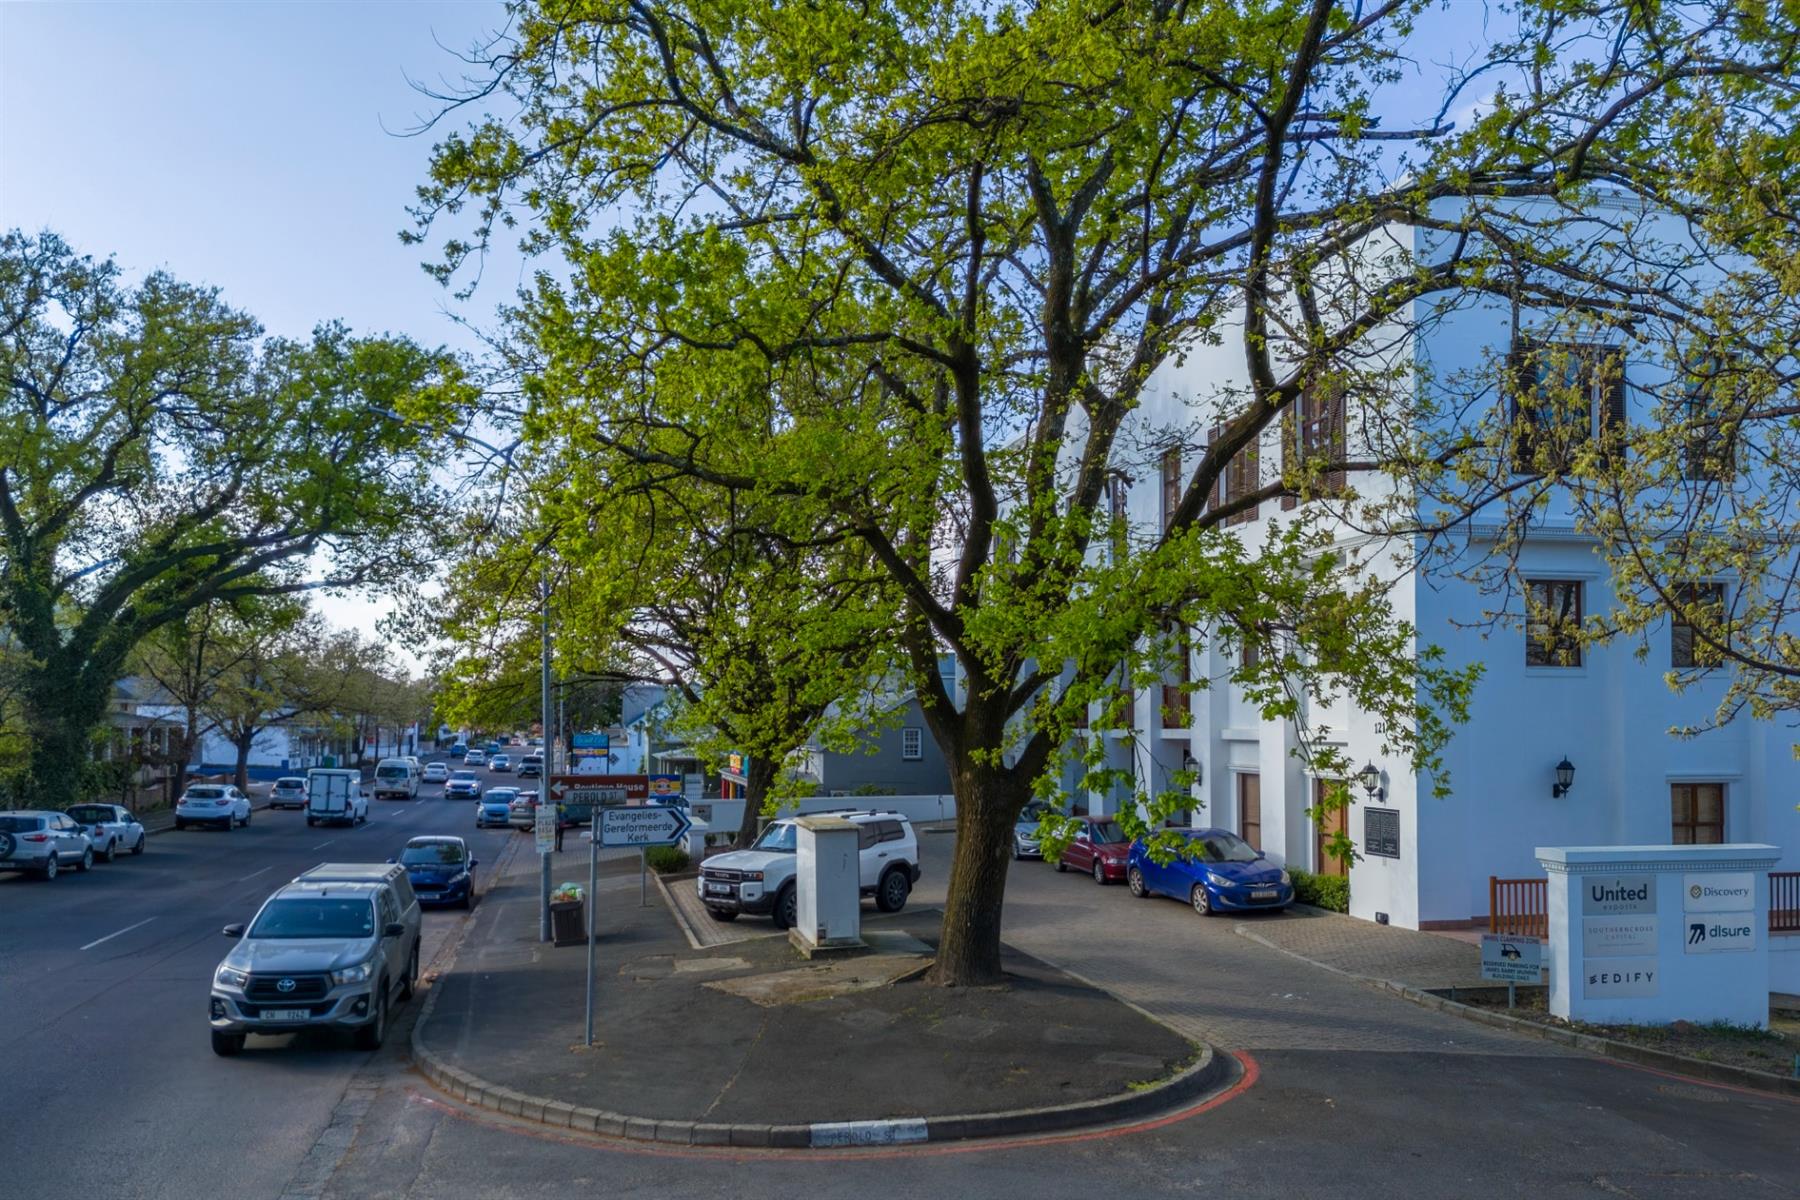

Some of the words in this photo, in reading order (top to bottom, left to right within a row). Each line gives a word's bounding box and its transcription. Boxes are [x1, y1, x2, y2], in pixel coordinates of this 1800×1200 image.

[573, 791, 607, 801] PEROLD
[608, 811, 662, 822] Evangelies-
[603, 823, 673, 833] Gereformeerde
[627, 833, 649, 842] Kerk
[1592, 882, 1648, 902] United
[1704, 887, 1750, 898] Discovery
[1603, 903, 1637, 911] exports
[1601, 972, 1654, 984] EDIFY
